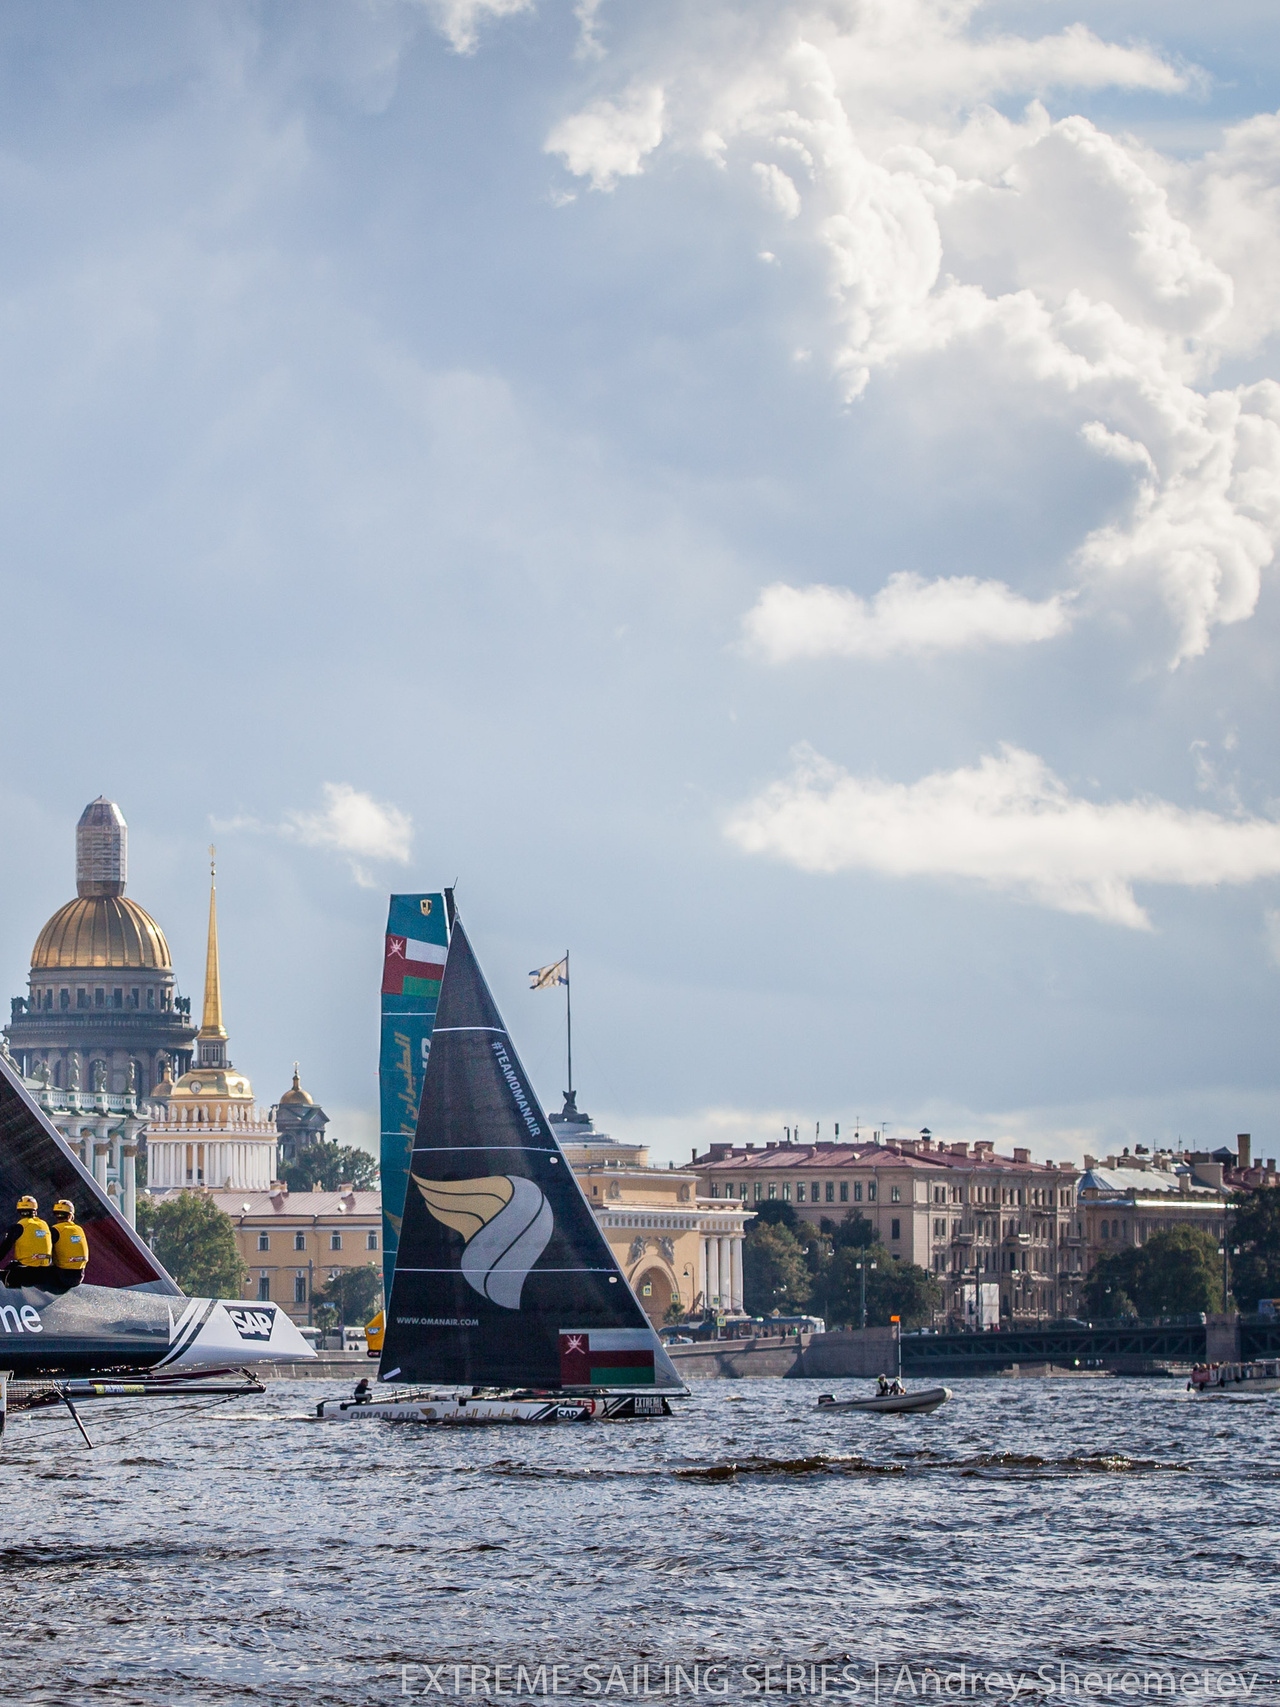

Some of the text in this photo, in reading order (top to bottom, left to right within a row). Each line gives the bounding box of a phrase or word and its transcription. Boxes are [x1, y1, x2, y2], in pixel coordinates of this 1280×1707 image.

[491, 1041, 541, 1138] #TEAMOMANAIR
[229, 1310, 272, 1336] SAP
[396, 1316, 479, 1326] WWW.OMANAIR.COM
